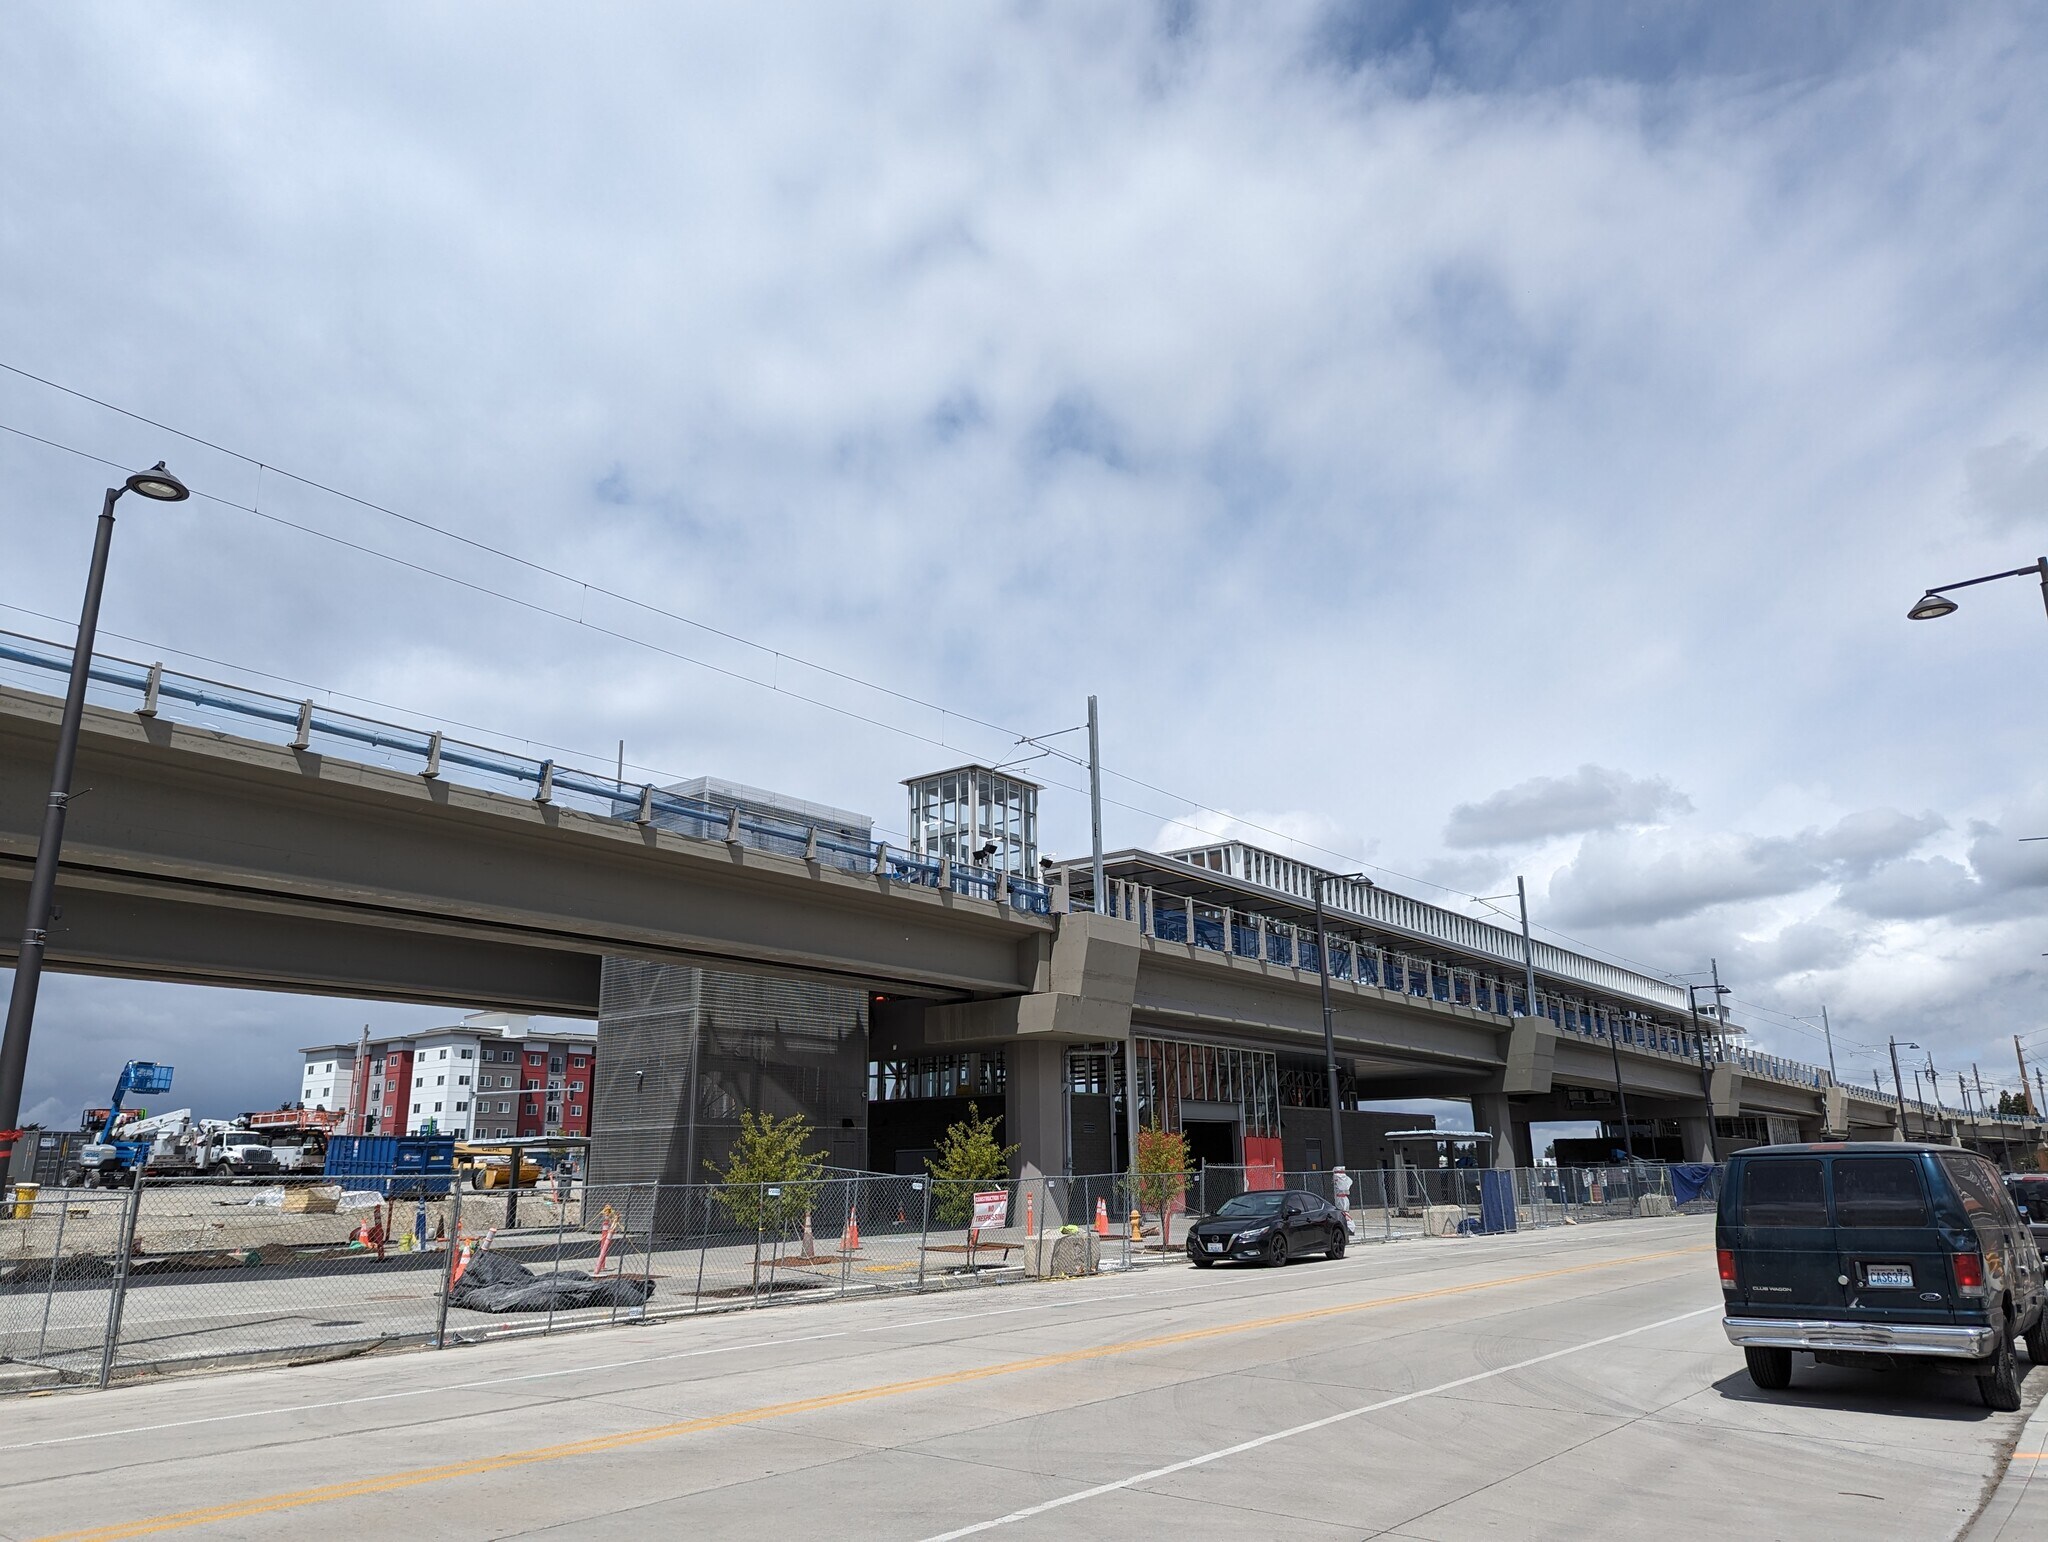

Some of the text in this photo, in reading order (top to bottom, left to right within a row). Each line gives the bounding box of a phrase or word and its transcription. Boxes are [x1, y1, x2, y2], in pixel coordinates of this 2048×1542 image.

[987, 1204, 995, 1212] NO
[975, 1213, 1005, 1222] TRESPASSING
[1870, 1272, 1911, 1283] CAS6373
